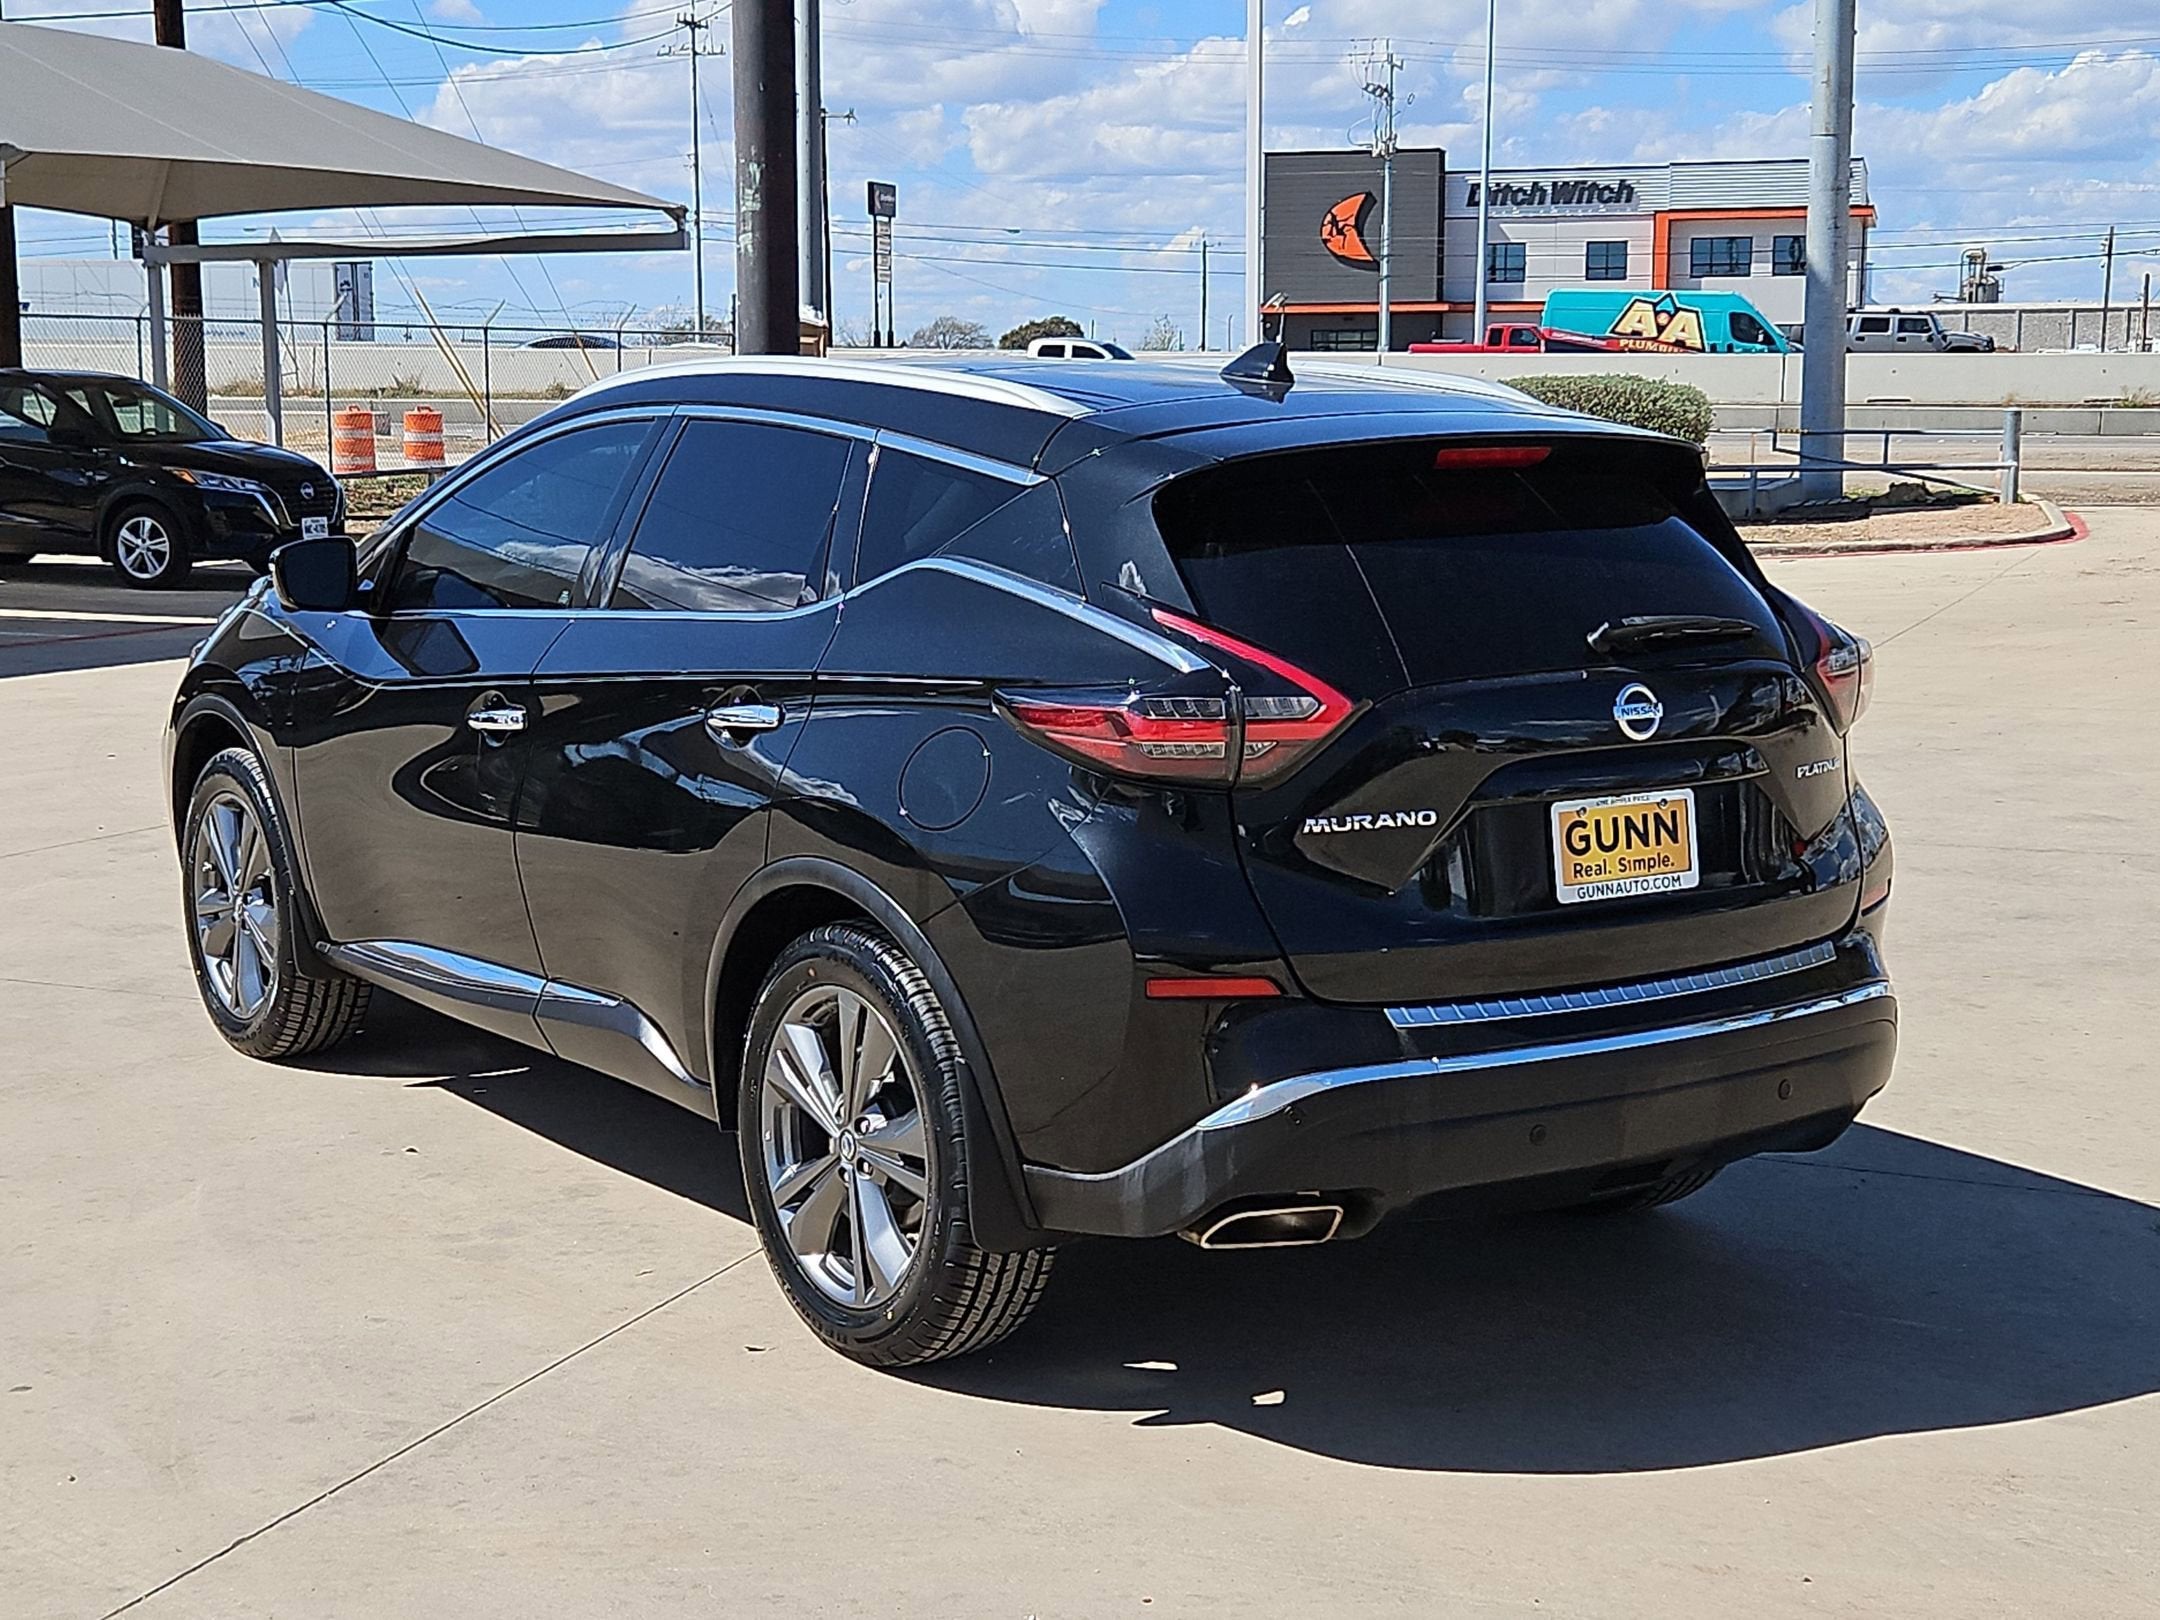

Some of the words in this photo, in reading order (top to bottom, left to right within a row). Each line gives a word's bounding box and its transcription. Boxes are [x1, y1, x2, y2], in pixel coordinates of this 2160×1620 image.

[1466, 182, 1547, 207] Ditch
[1550, 180, 1634, 205] Witch
[1619, 339, 1684, 353] PLUMBI
[1620, 704, 1660, 717] NISSAN
[1302, 810, 1438, 834] MURANO
[1565, 809, 1679, 857] GUNN
[1573, 859, 1612, 879] Real.
[1618, 852, 1675, 873] Simple.
[1577, 874, 1682, 900] GUNNAUTO.COM
